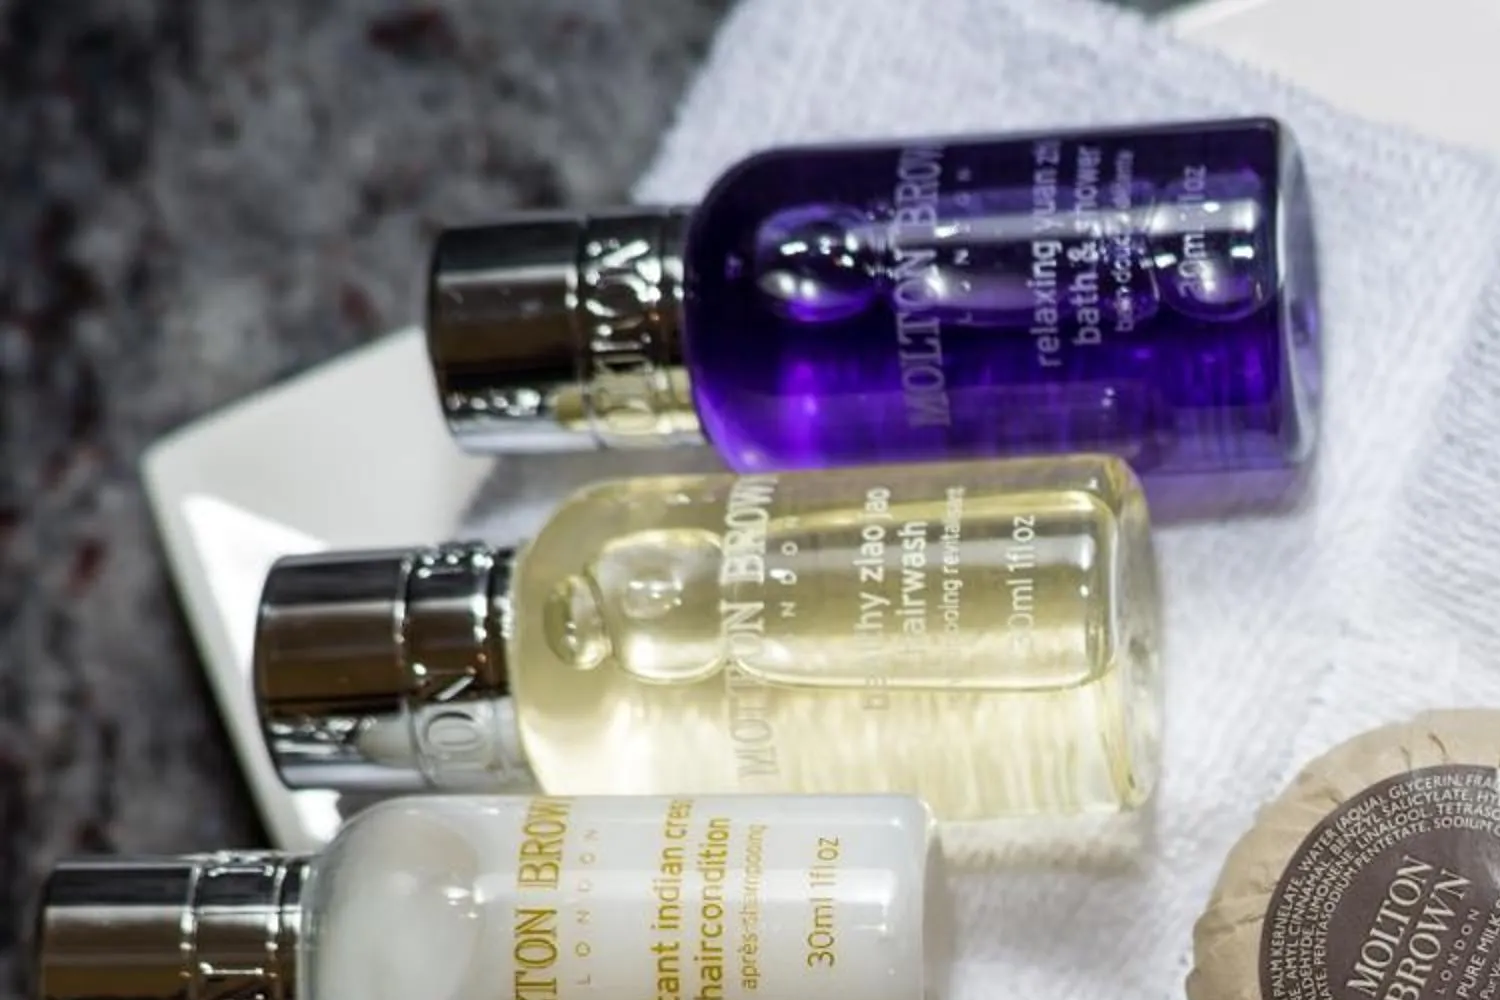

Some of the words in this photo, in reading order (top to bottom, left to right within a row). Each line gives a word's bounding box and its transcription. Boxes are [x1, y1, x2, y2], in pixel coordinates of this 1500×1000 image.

[896, 144, 943, 230] BROW
[1030, 169, 1062, 234] yuan
[1066, 241, 1098, 263] &
[894, 247, 951, 427] MOLTON
[1025, 241, 1062, 367] relaxing
[1070, 272, 1102, 345] bath
[517, 797, 572, 889] BROW
[576, 829, 598, 985] LONDON
[652, 847, 684, 930] indian
[807, 897, 834, 968] 30ml
[1268, 958, 1286, 998] PALM
[1295, 825, 1338, 873] WATER
[1284, 938, 1298, 980] AMYL
[1327, 809, 1383, 857] BENZYL
[1313, 863, 1359, 965] PENTASODIUM
[1432, 815, 1494, 833] SODIUM
[1347, 854, 1434, 998] MOLTON
[1435, 909, 1479, 995] LONDON
[1456, 954, 1486, 998] PURE
